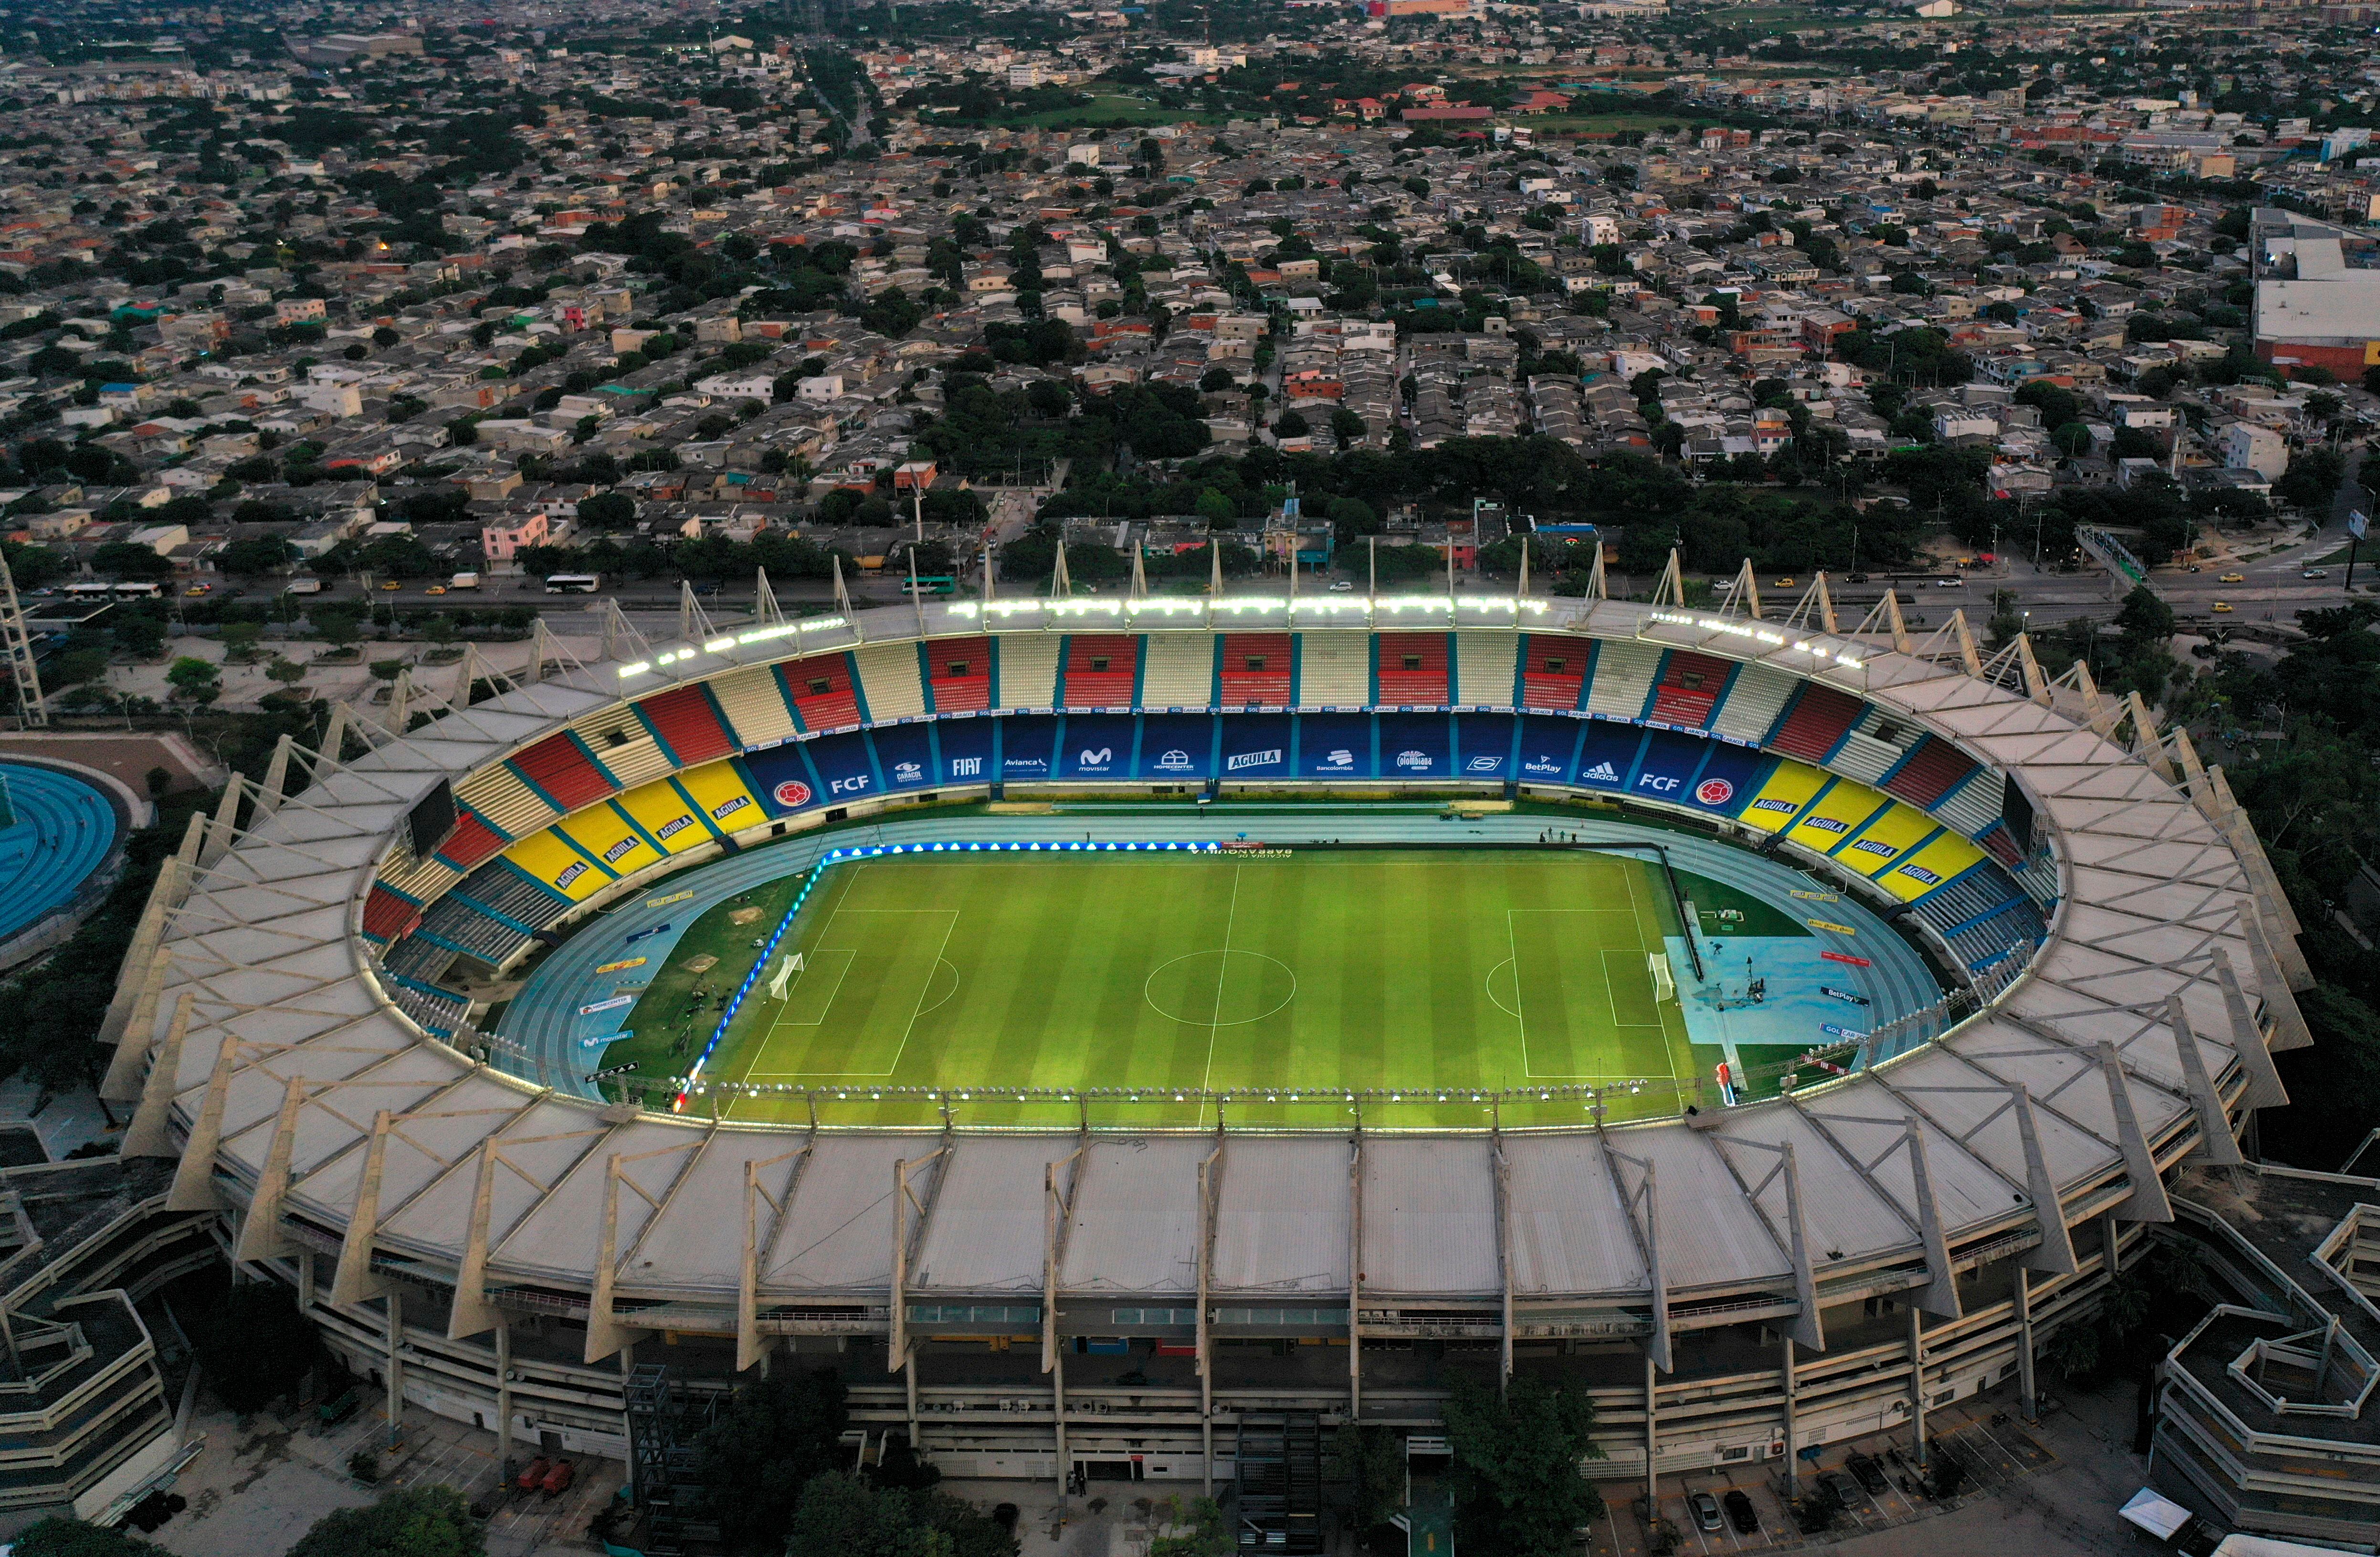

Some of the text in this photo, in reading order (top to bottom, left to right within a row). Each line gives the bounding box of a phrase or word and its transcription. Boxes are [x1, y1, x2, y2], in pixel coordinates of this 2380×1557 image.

[798, 732, 819, 740] CARACOL
[1685, 728, 1706, 736] CARACOL
[759, 741, 781, 749] CARACOL
[1723, 736, 1744, 745] CARACOL
[1231, 751, 1277, 768] AGUILA
[1397, 756, 1432, 767] Colombiana
[953, 757, 982, 776] FIAT
[1525, 763, 1561, 773] BetPlay
[897, 771, 922, 780] CARACOL
[1583, 770, 1619, 781] adidas
[1639, 773, 1680, 791] FCF
[831, 775, 869, 794] FCF
[715, 798, 748, 820] AGUILA
[1757, 799, 1793, 813] AGUILA
[659, 815, 692, 840] AGUILA
[1807, 818, 1845, 833] AGUILA
[606, 836, 638, 863] AGUILA
[1855, 841, 1895, 857] AGUILA
[557, 862, 588, 889] AGUILA
[1902, 865, 1938, 884] AGUILA
[1829, 989, 1853, 1002] BetPlay
[593, 997, 627, 1009] HOMECENTER
[1826, 1026, 1840, 1034] GOL
[600, 1033, 628, 1043] movistar
